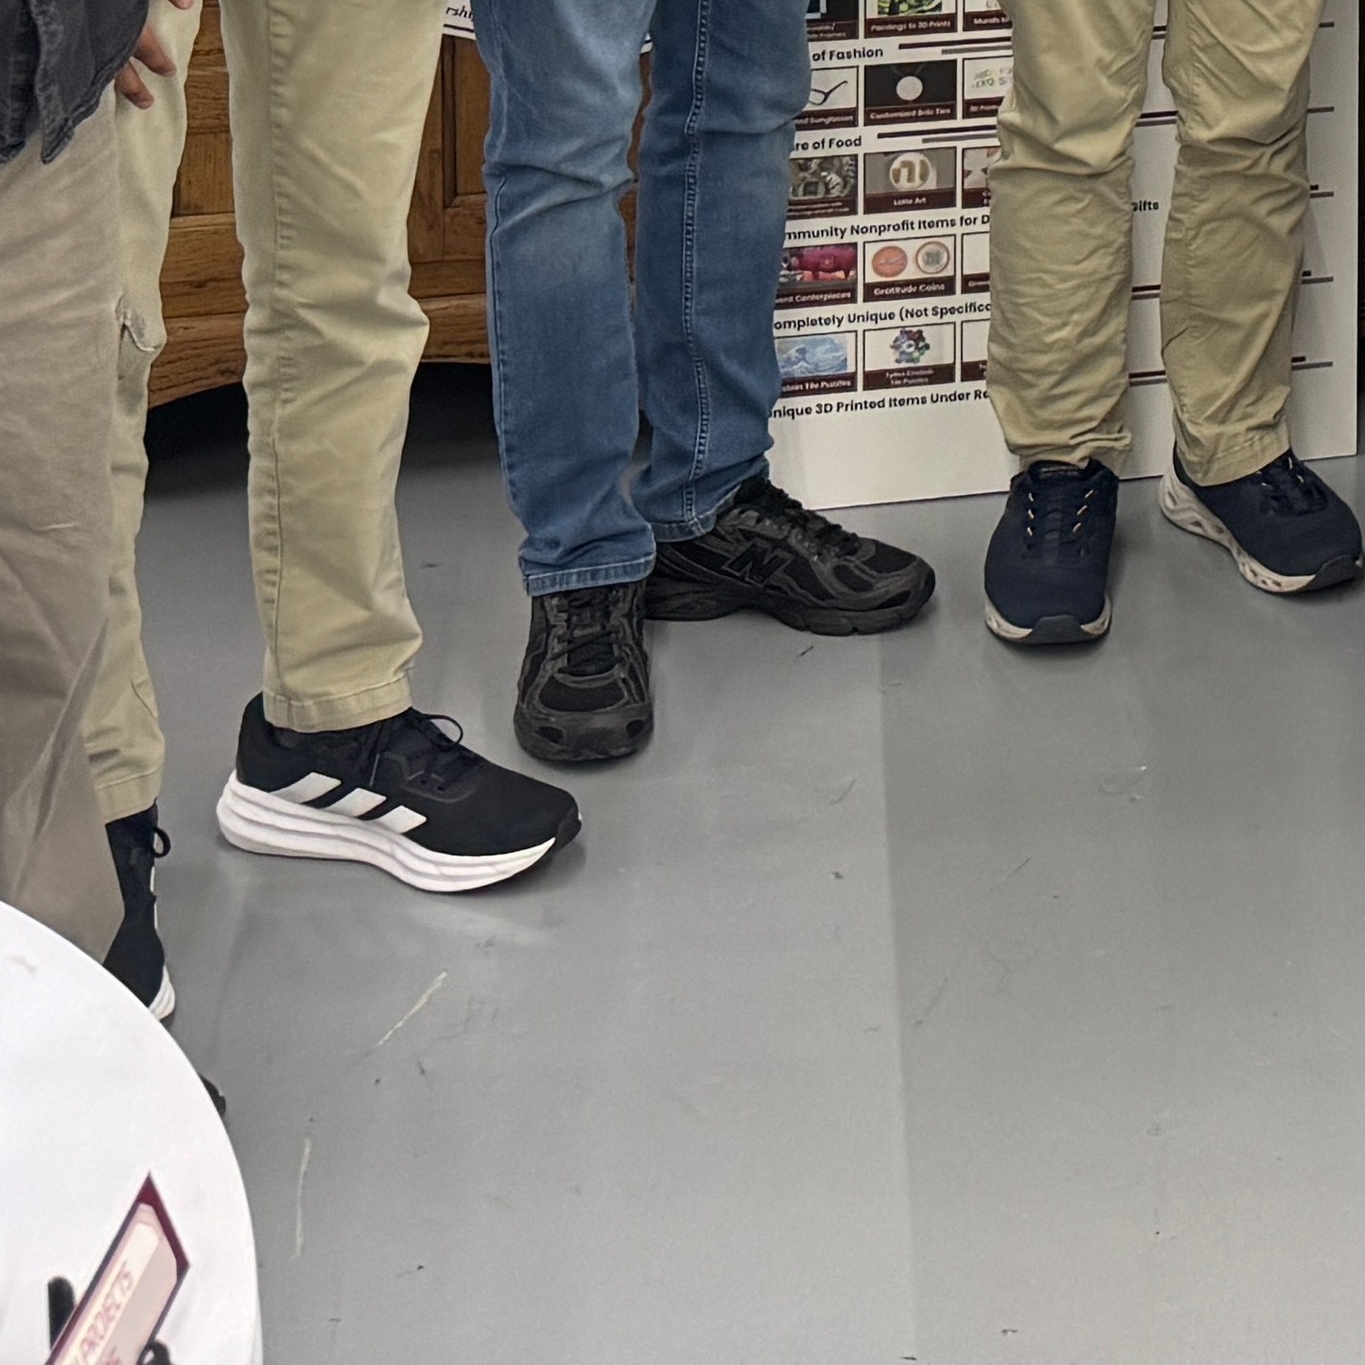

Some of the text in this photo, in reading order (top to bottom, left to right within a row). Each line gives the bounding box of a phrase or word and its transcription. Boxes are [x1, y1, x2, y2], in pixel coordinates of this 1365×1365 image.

[812, 47, 884, 62] of Fashion
[812, 138, 826, 150] of
[829, 136, 862, 149] Food
[850, 221, 915, 236] Nonprofit
[918, 217, 956, 230] Items
[959, 214, 978, 226] for
[774, 314, 844, 330] ompletely
[848, 310, 896, 324] Unique
[899, 306, 928, 321] (Not
[815, 403, 833, 414] 3D
[836, 399, 886, 412] Printed
[888, 396, 926, 408] Items
[930, 390, 971, 405] Under
